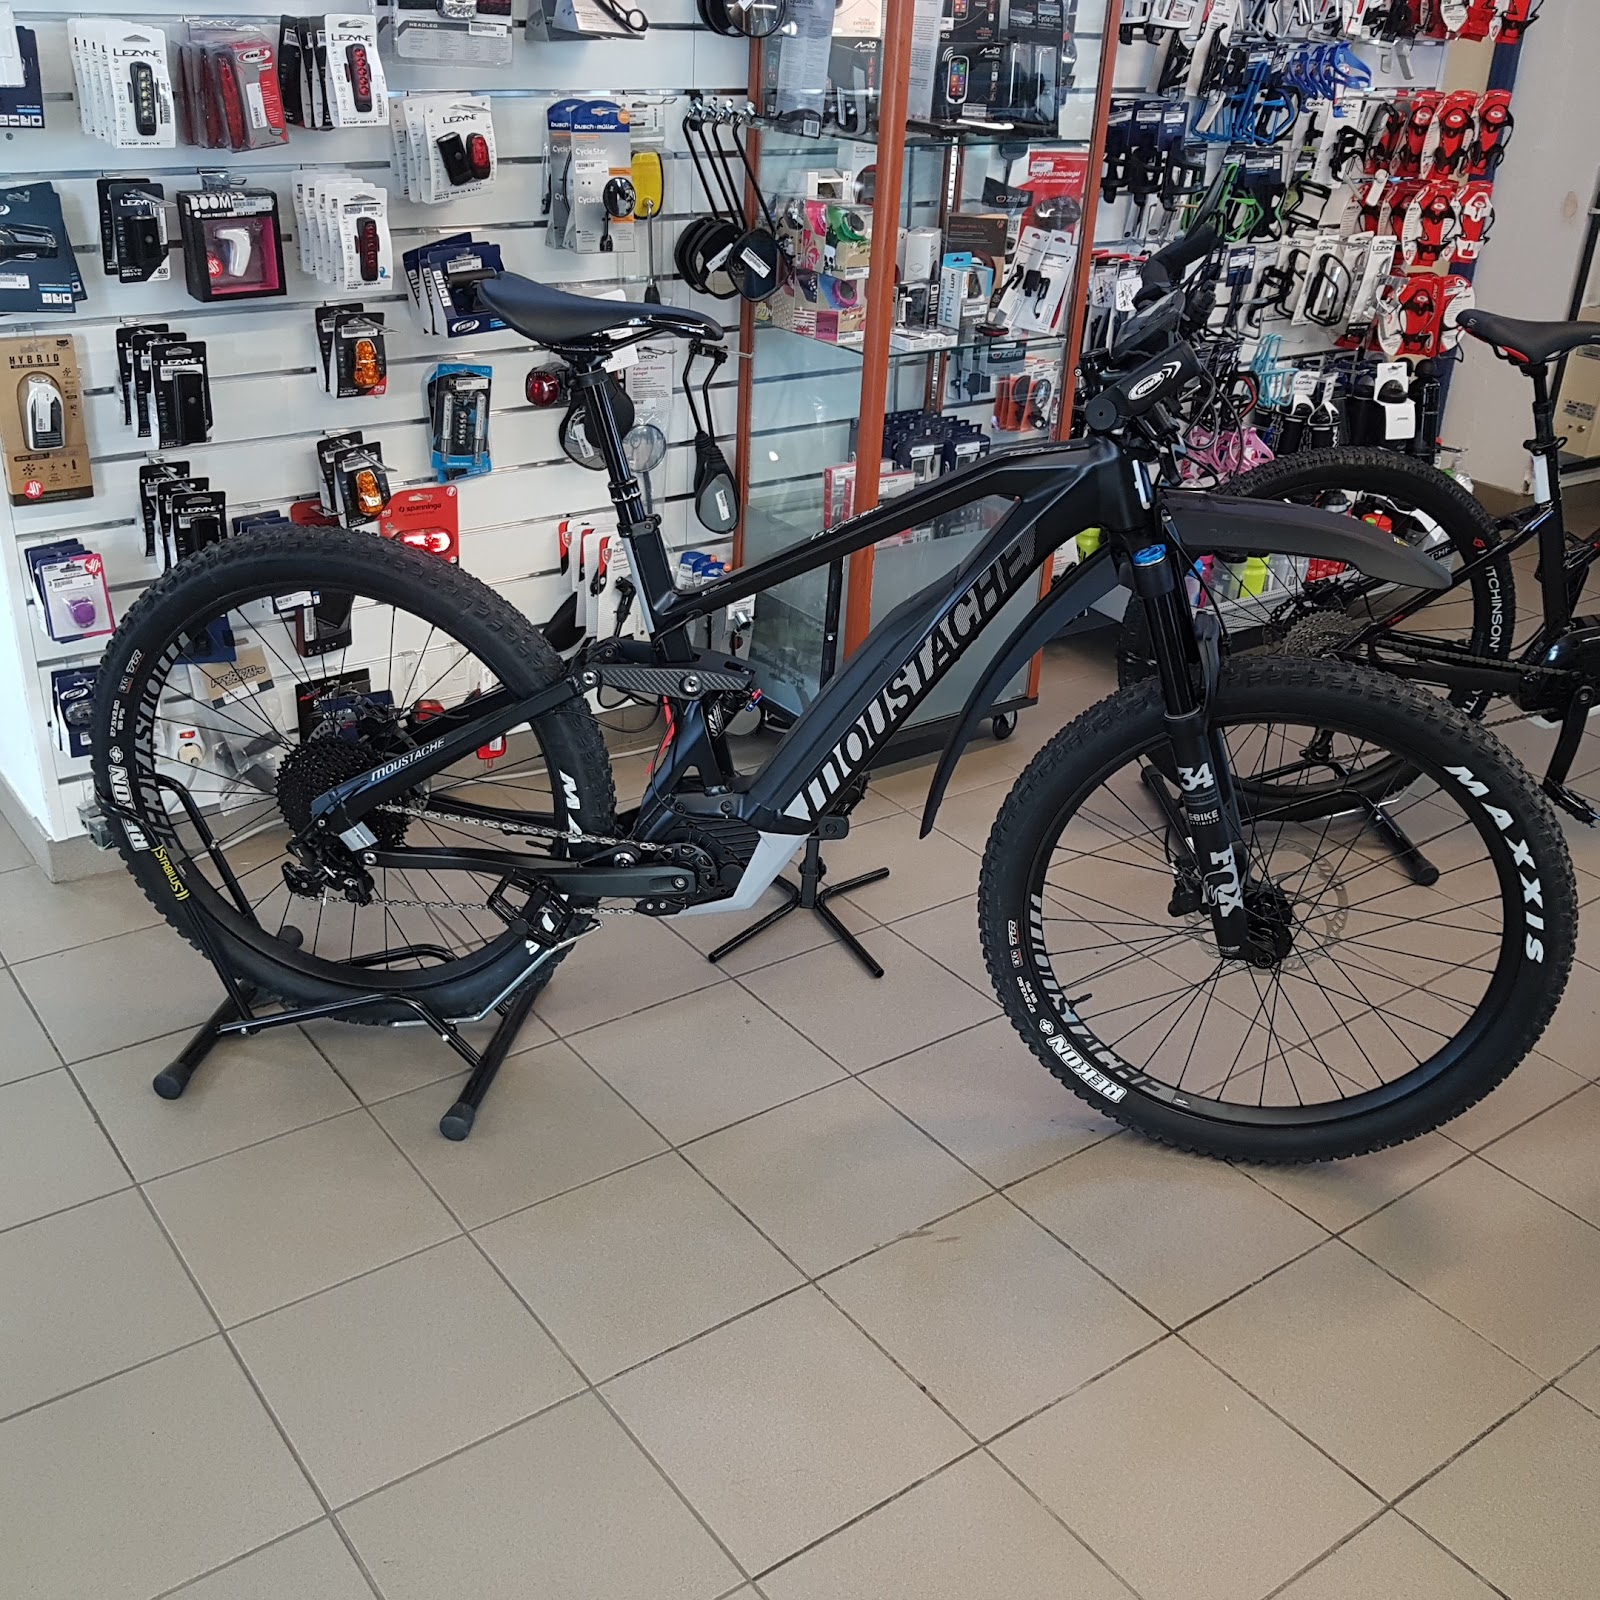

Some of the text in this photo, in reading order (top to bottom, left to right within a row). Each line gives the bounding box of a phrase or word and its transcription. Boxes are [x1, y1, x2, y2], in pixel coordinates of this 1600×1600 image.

[331, 33, 374, 42] LEZYNE
[113, 48, 162, 57] LEZYNE
[442, 114, 478, 124] LEZYNE
[8, 353, 60, 366] HYBRID
[160, 357, 198, 366] LEZYNE
[181, 505, 217, 514] LEZYNE
[407, 502, 442, 513] spanninga
[783, 521, 1038, 821] MOUSTACHE
[371, 737, 445, 782] MOUSTACHE
[1177, 762, 1214, 791] 34
[1443, 766, 1545, 965] MAXXIS
[1202, 843, 1244, 918] FOX
[1046, 1034, 1128, 1104] REKON
